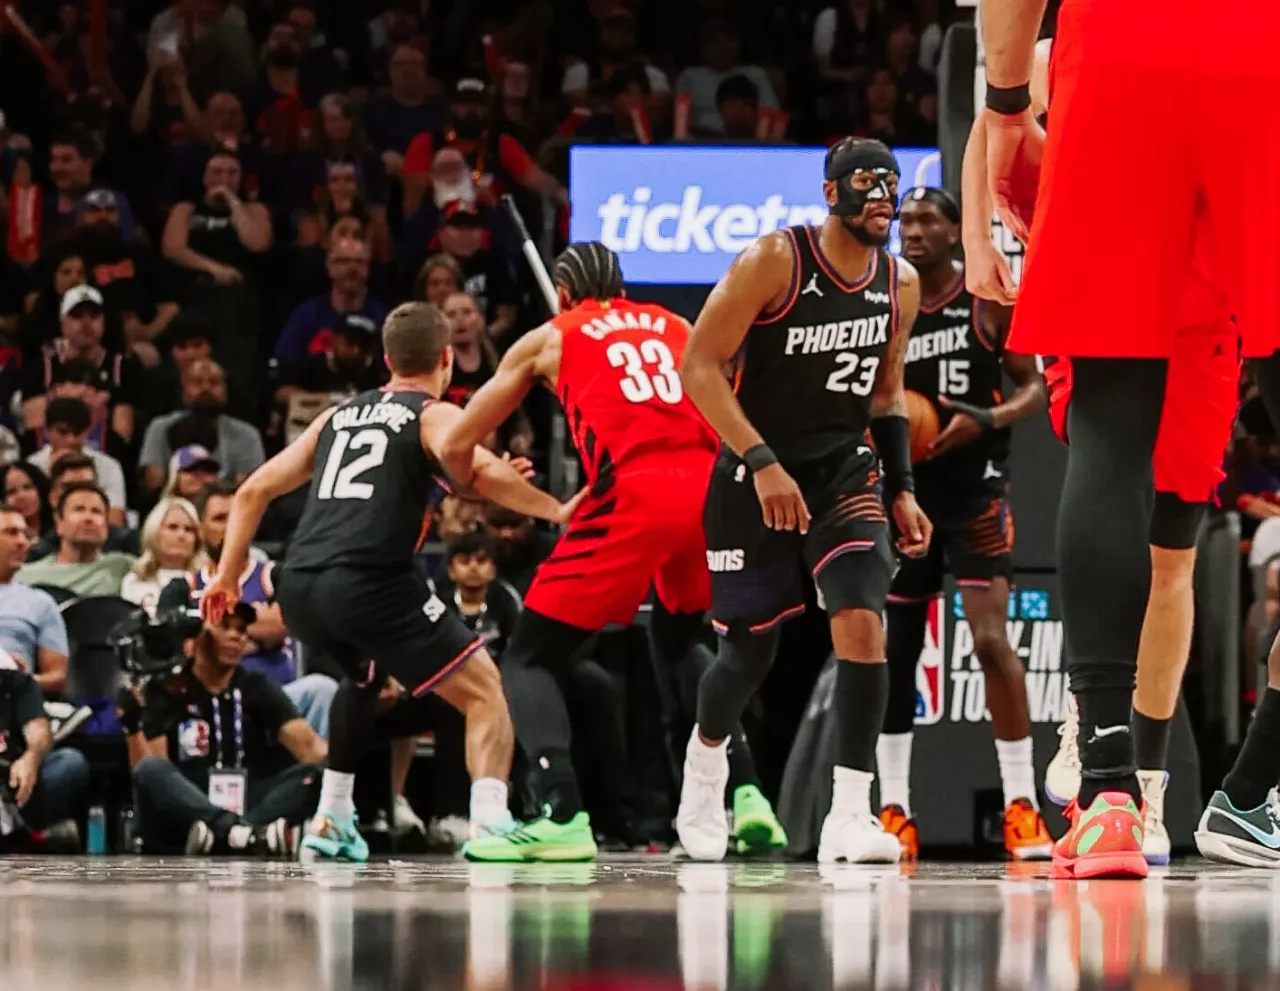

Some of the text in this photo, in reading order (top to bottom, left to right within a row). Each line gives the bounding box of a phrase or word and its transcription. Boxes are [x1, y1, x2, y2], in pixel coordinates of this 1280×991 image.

[784, 313, 890, 356] PHOENIX
[904, 324, 970, 364] OENIX
[606, 338, 684, 405] 33
[825, 352, 880, 397] 23
[937, 359, 970, 395] 15
[317, 428, 389, 500] 12
[950, 620, 1063, 671] PY-IN
